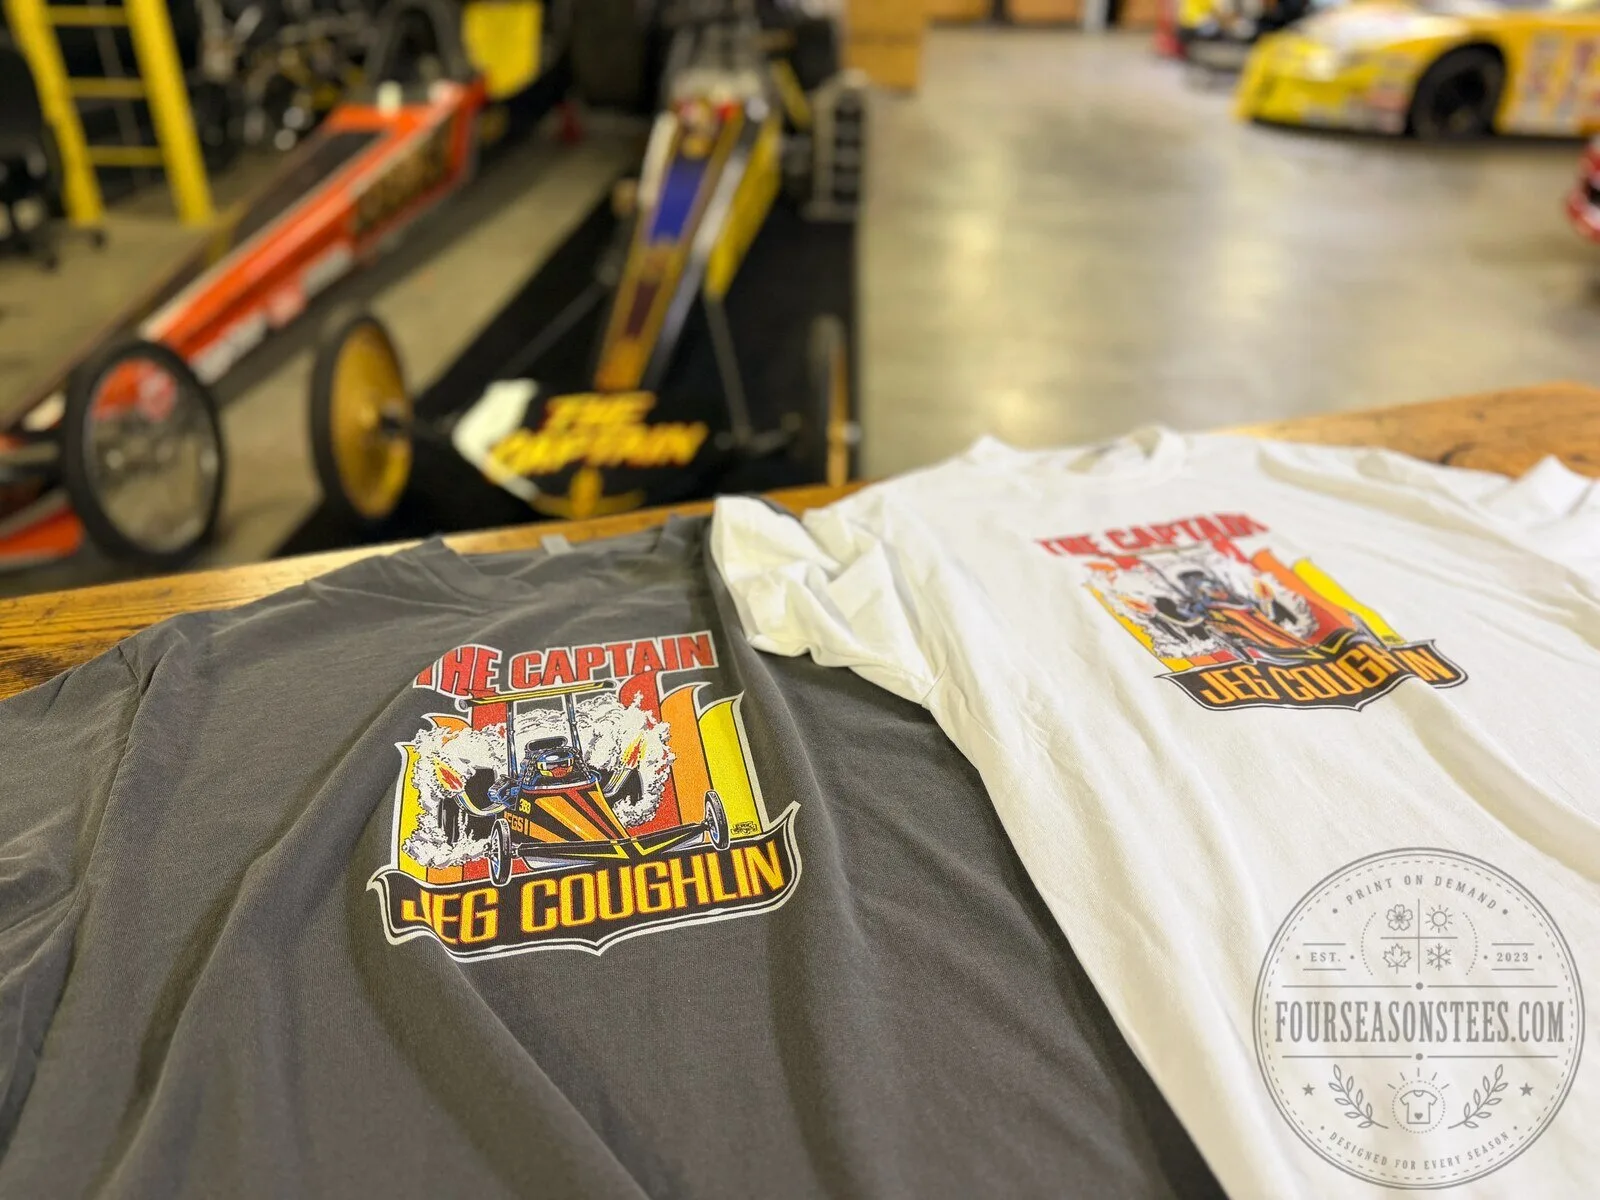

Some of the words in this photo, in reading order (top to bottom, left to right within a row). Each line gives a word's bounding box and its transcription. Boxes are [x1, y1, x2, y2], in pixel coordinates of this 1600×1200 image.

[508, 632, 716, 689] CAPTAIN
[1200, 664, 1280, 704] JEG
[401, 887, 499, 944] JEG
[520, 841, 785, 934] COUGHLIN
